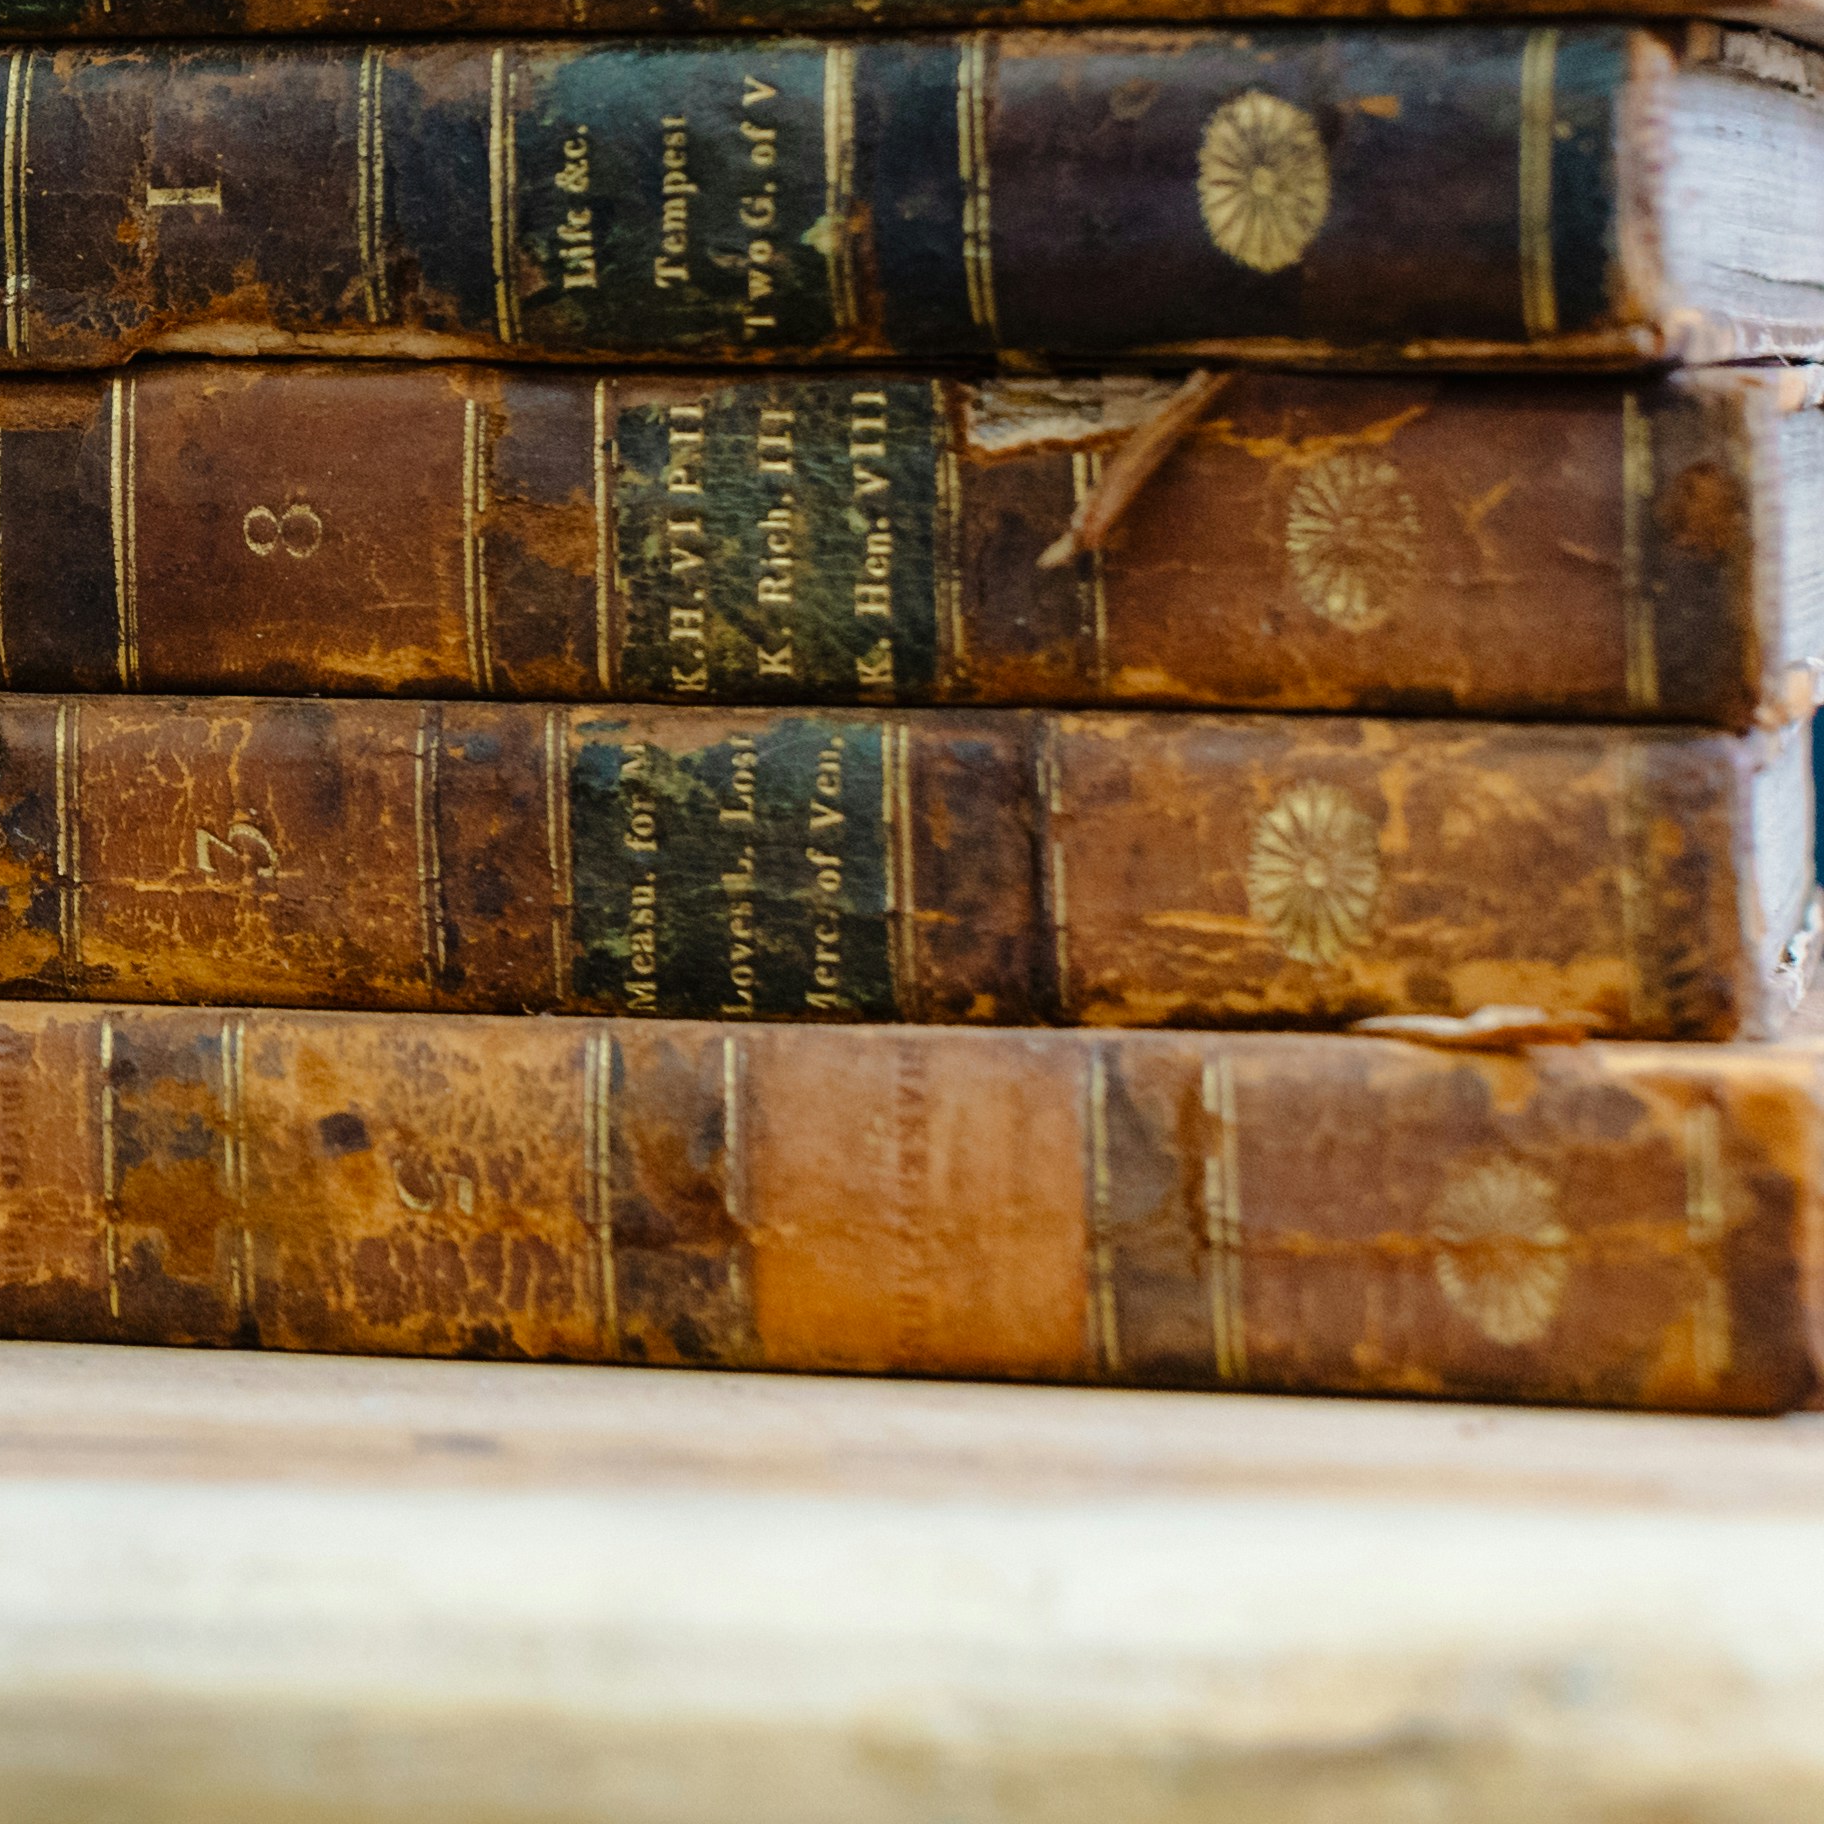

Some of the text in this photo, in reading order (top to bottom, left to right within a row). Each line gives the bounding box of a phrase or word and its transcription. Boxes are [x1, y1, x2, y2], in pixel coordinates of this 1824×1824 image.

[653, 115, 699, 289] Tempest
[739, 75, 778, 341] Two G. of V
[556, 207, 599, 290] Life
[242, 502, 324, 559] 8
[756, 408, 796, 677] K. Rich. III
[848, 391, 894, 686] K. Hen. VIII
[622, 792, 659, 852] for
[719, 735, 758, 821] Lost
[809, 736, 846, 830] Ven.
[194, 822, 278, 878] 3
[804, 847, 844, 893] of
[623, 871, 658, 1012] Measu.
